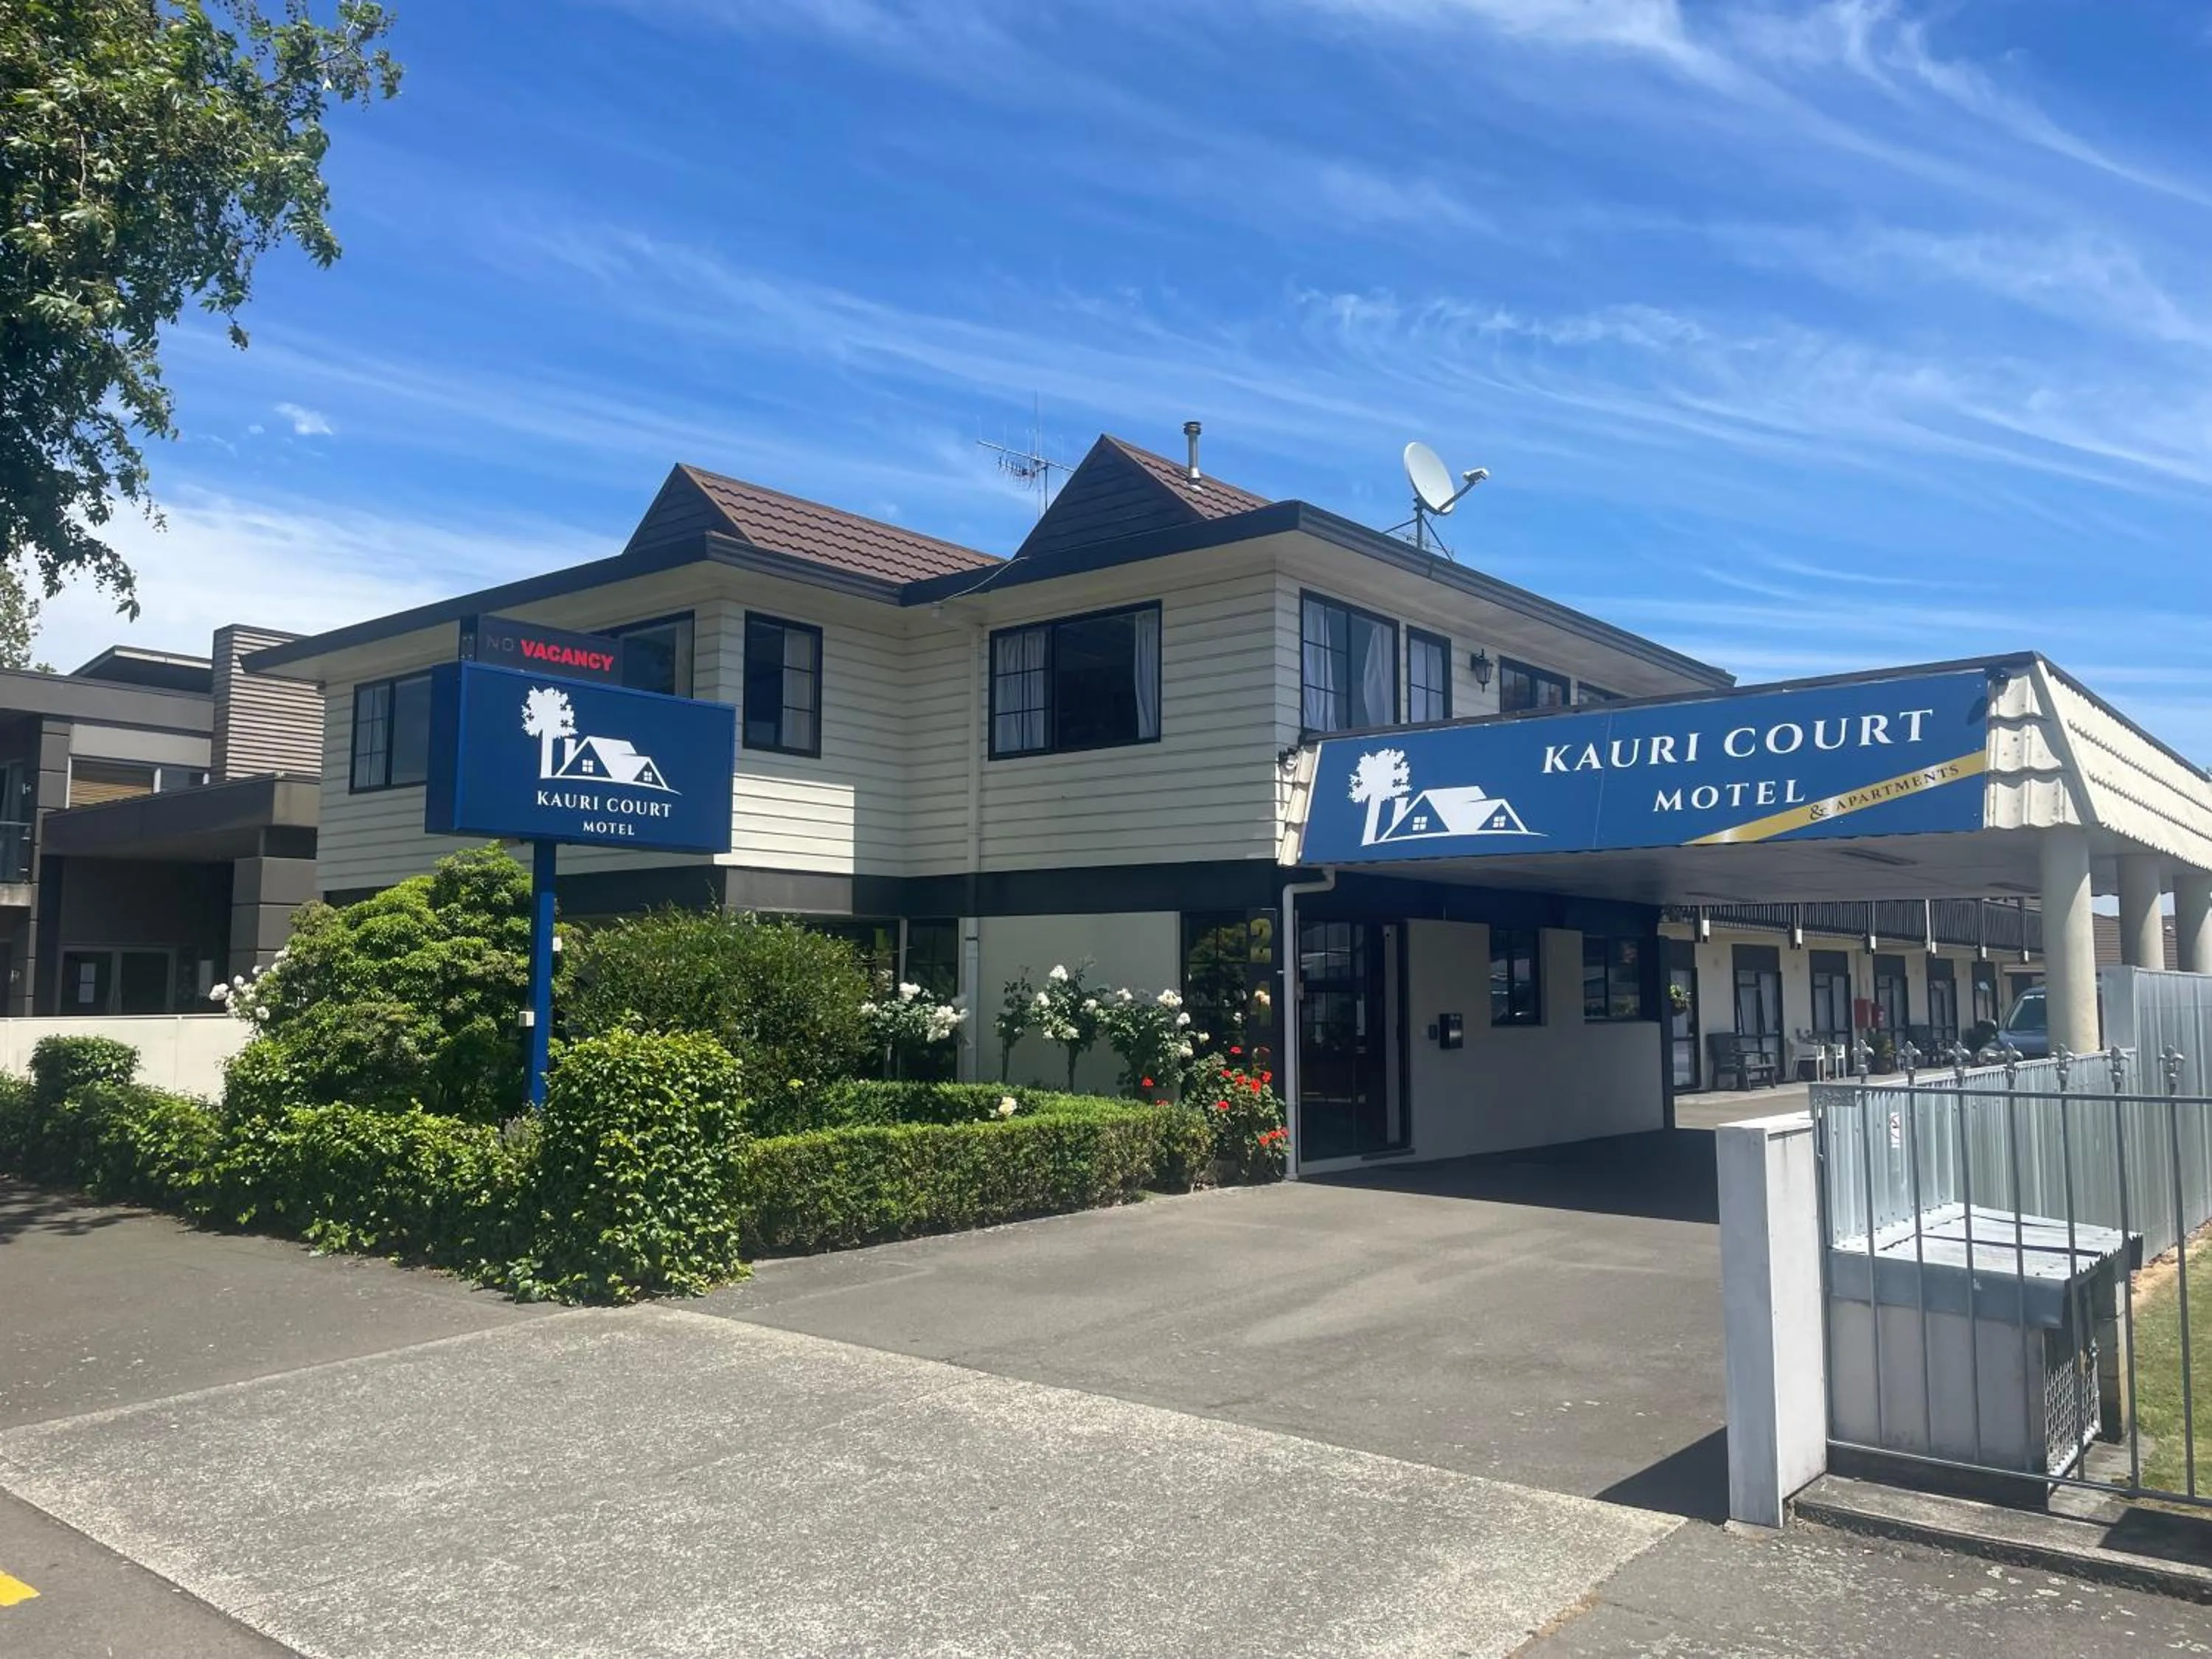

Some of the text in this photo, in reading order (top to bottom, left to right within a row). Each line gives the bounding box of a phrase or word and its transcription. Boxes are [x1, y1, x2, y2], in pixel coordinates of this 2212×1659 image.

[486, 635, 613, 671] NO VACANCY
[1543, 709, 1933, 773] KAURI COURT
[538, 790, 672, 818] KAURI COURT
[1653, 779, 1805, 813] MOTEL
[1809, 765, 1959, 821] & APARTMENTS
[583, 821, 635, 836] MOTEL
